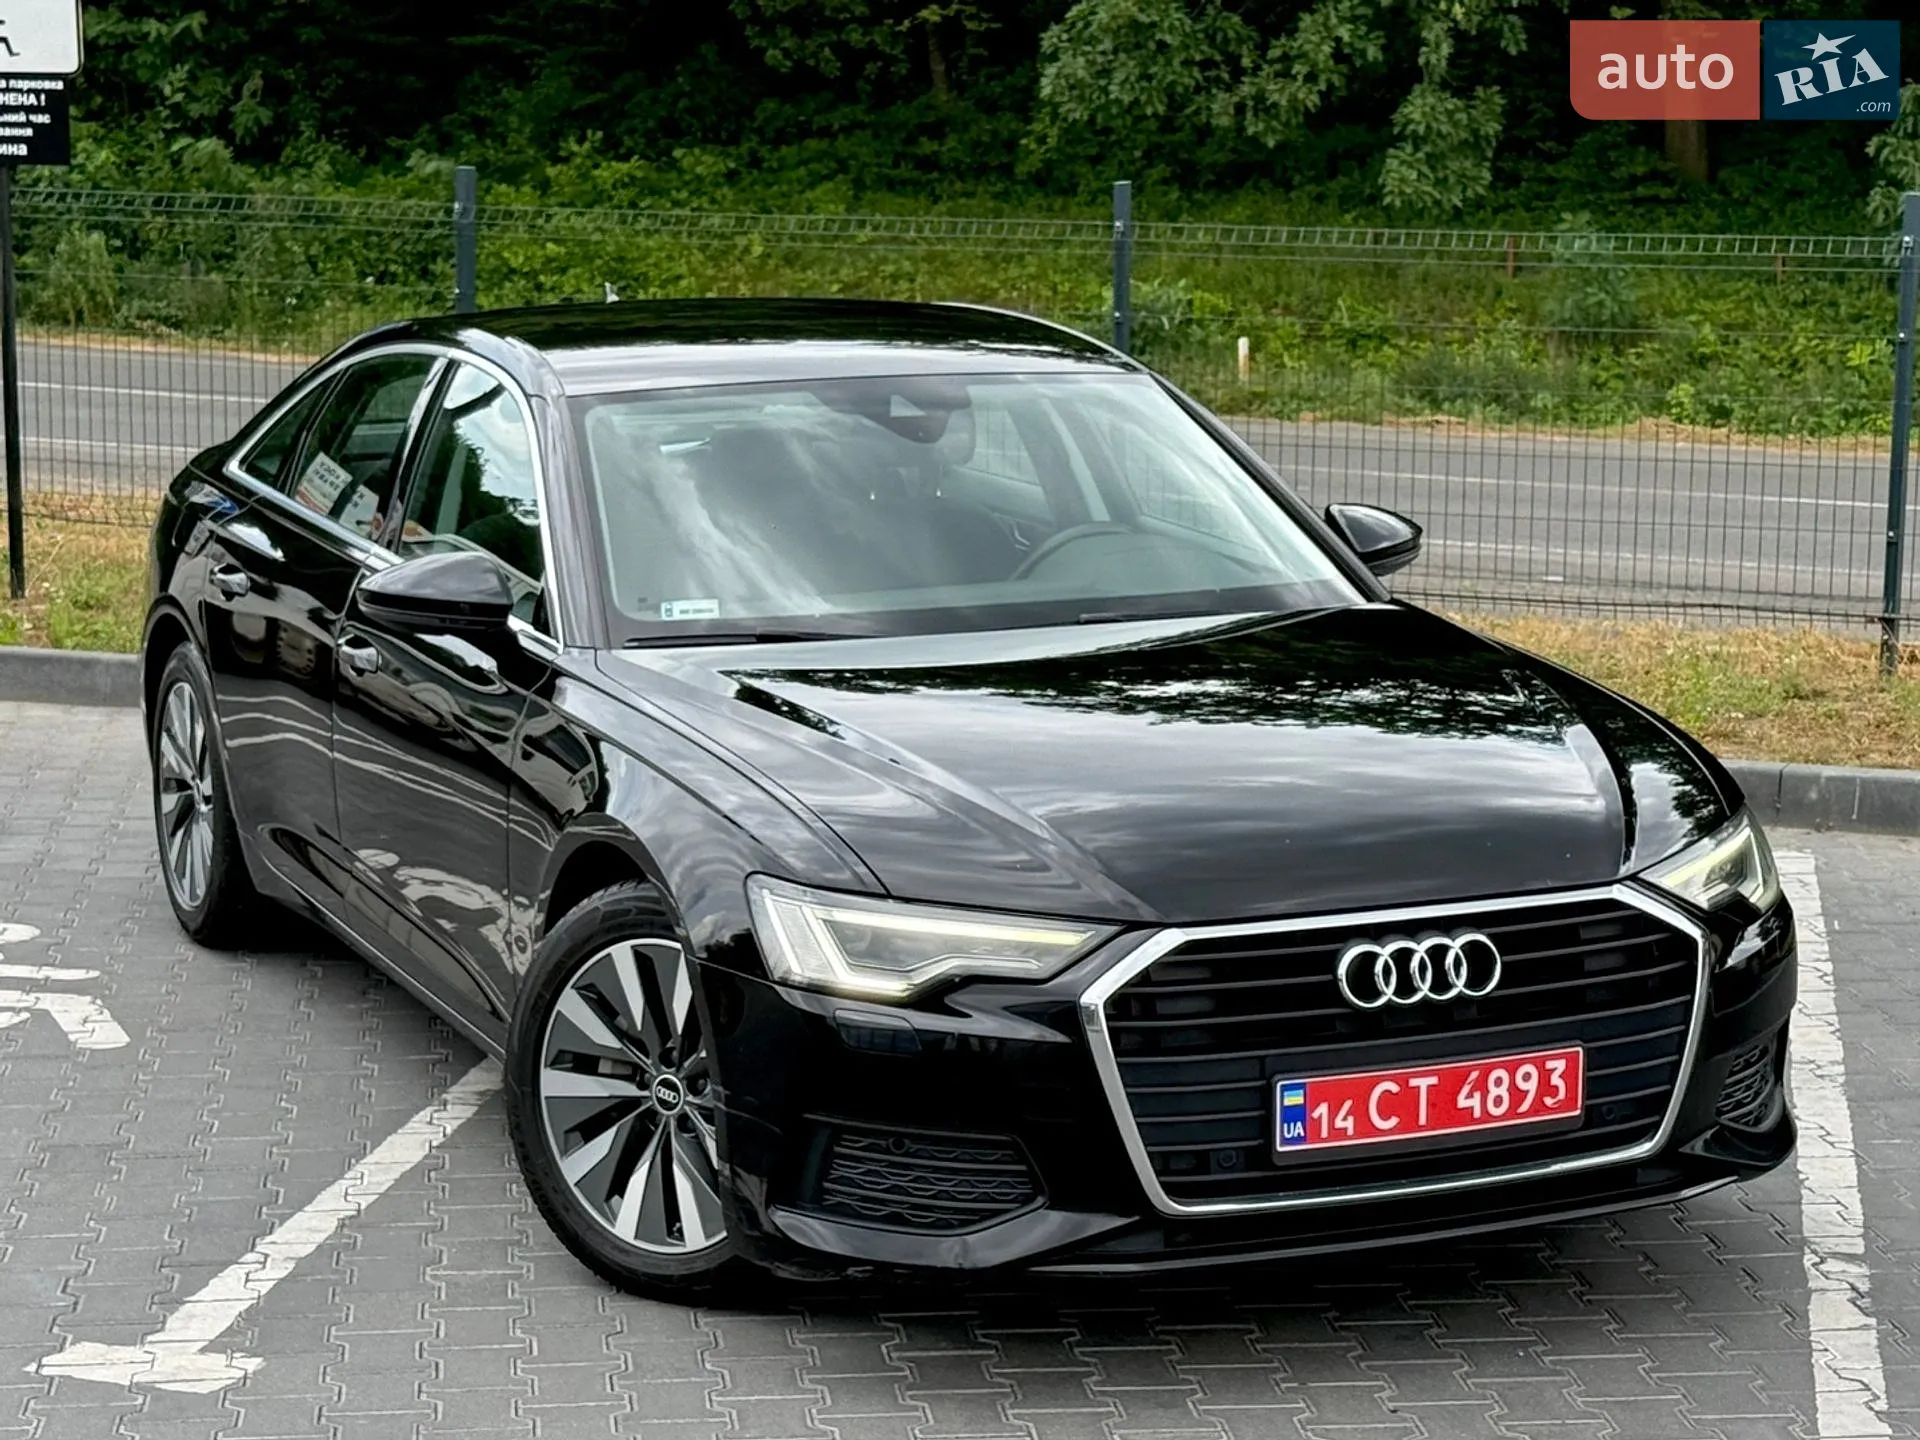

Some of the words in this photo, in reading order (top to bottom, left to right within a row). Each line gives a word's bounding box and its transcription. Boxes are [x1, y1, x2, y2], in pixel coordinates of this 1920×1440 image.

[8, 79, 64, 91] парковка
[28, 113, 51, 124] час
[1311, 1099, 1355, 1139] 14
[1367, 1076, 1439, 1131] CT
[1456, 1058, 1567, 1119] 4893
[1283, 1121, 1305, 1139] UA
